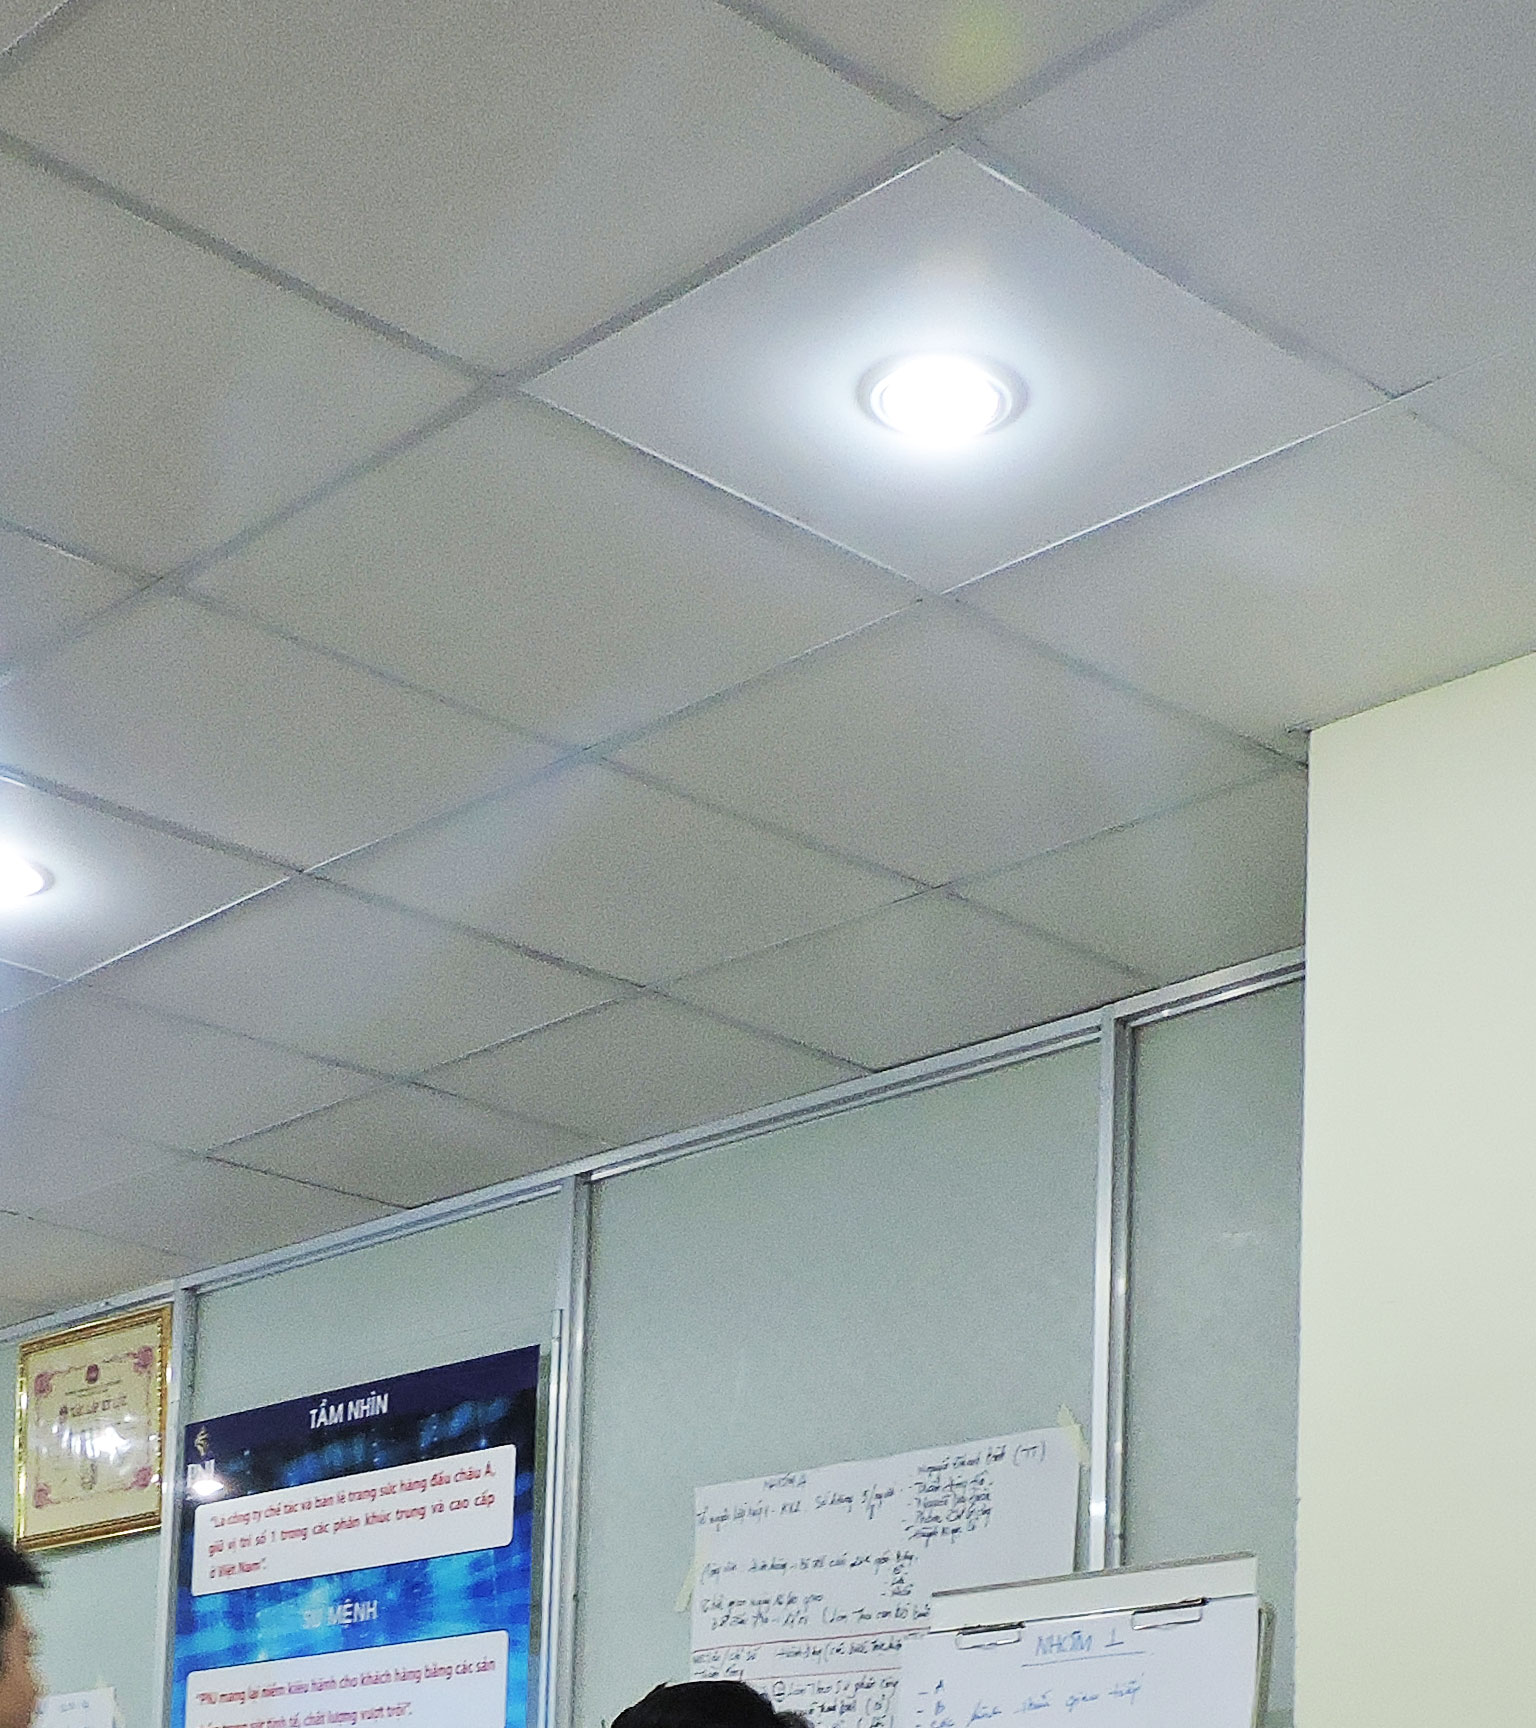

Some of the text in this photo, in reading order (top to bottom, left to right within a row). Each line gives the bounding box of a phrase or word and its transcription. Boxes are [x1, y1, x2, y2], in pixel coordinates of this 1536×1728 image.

[309, 1390, 389, 1430] TẦM NHÌN
[327, 1598, 378, 1629] MỆNH
